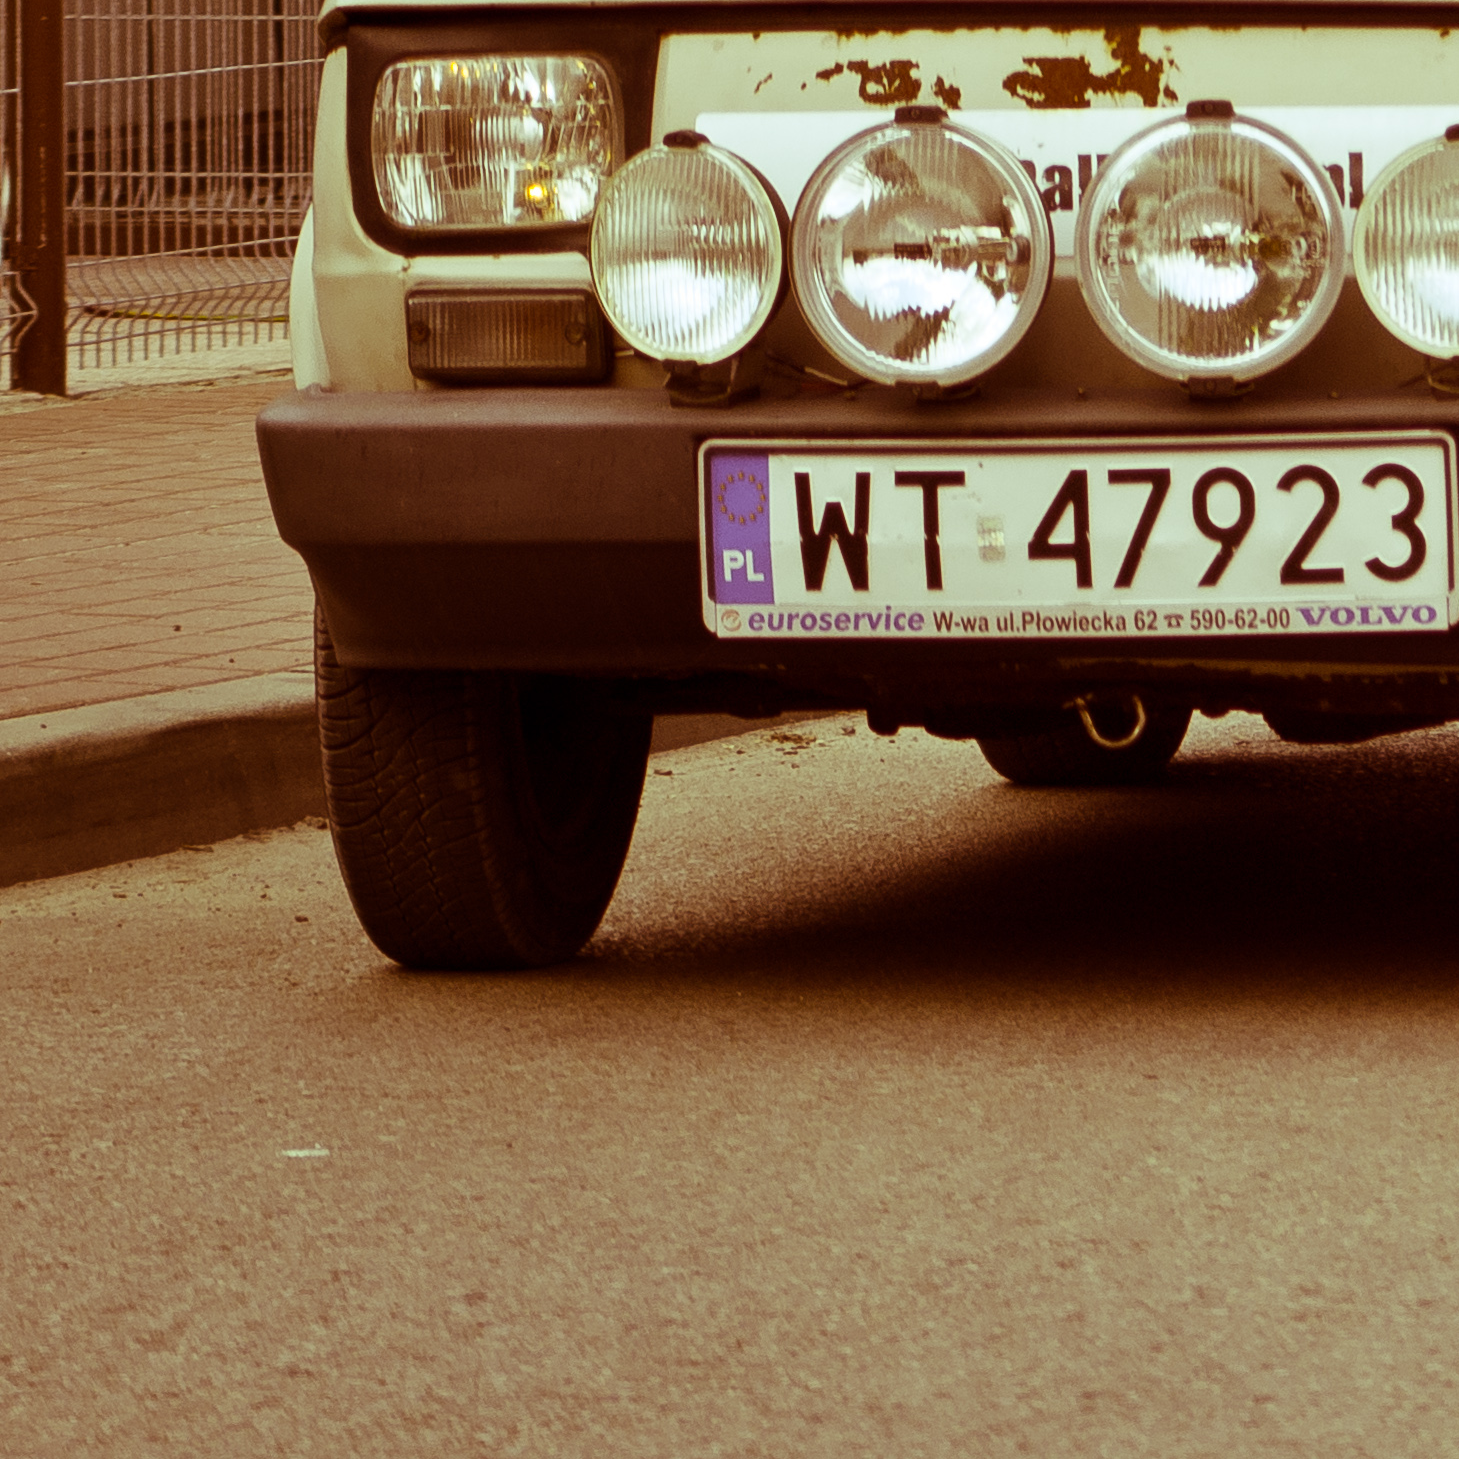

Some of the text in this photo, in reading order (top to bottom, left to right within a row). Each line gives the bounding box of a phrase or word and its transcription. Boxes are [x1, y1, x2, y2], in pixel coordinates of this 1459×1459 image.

[793, 463, 1428, 593] WT 47923
[722, 548, 765, 583] PL
[747, 604, 1438, 634] euroservice W-wa ul.Płowiecka 62 590-62-00 VOLVO
